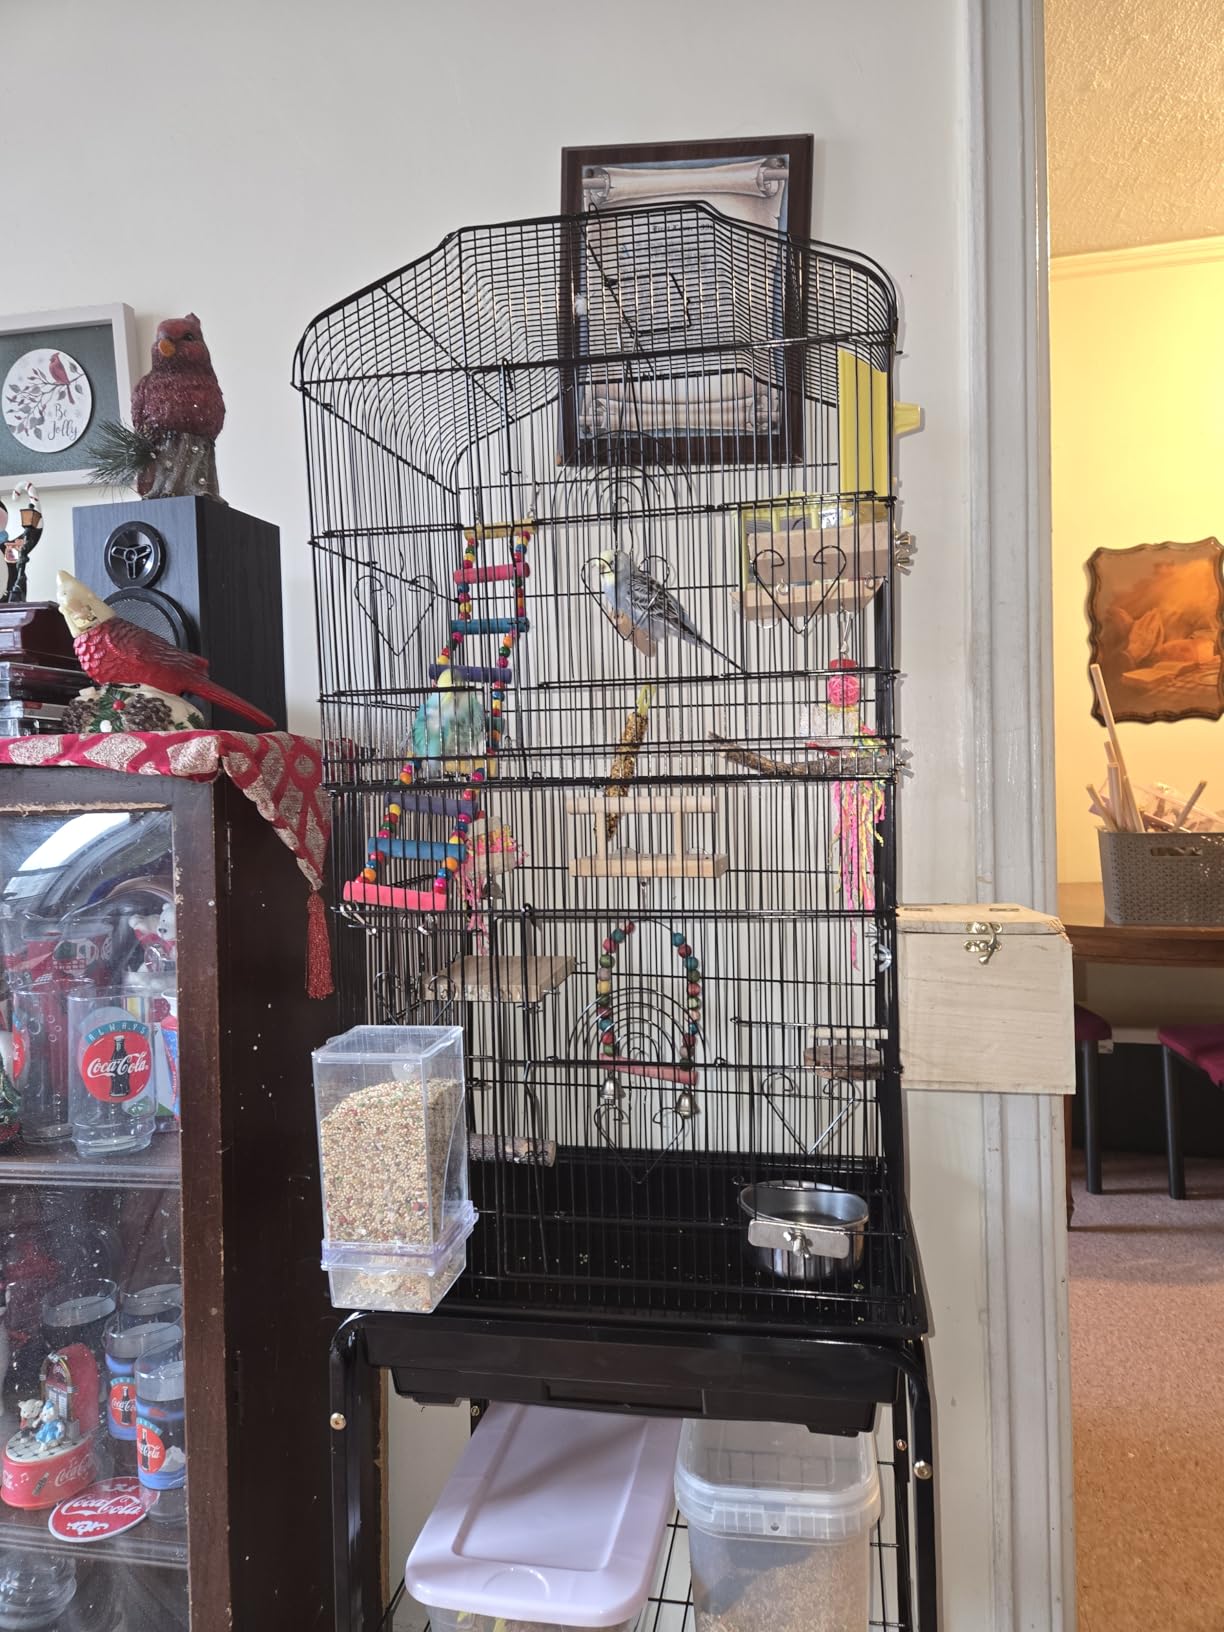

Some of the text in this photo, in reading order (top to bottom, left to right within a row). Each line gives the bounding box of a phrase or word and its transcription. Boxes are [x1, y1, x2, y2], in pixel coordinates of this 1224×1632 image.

[47, 418, 78, 441] Jolly
[87, 1023, 147, 1043] ALWAYS
[87, 1051, 147, 1079] Coca-Cola
